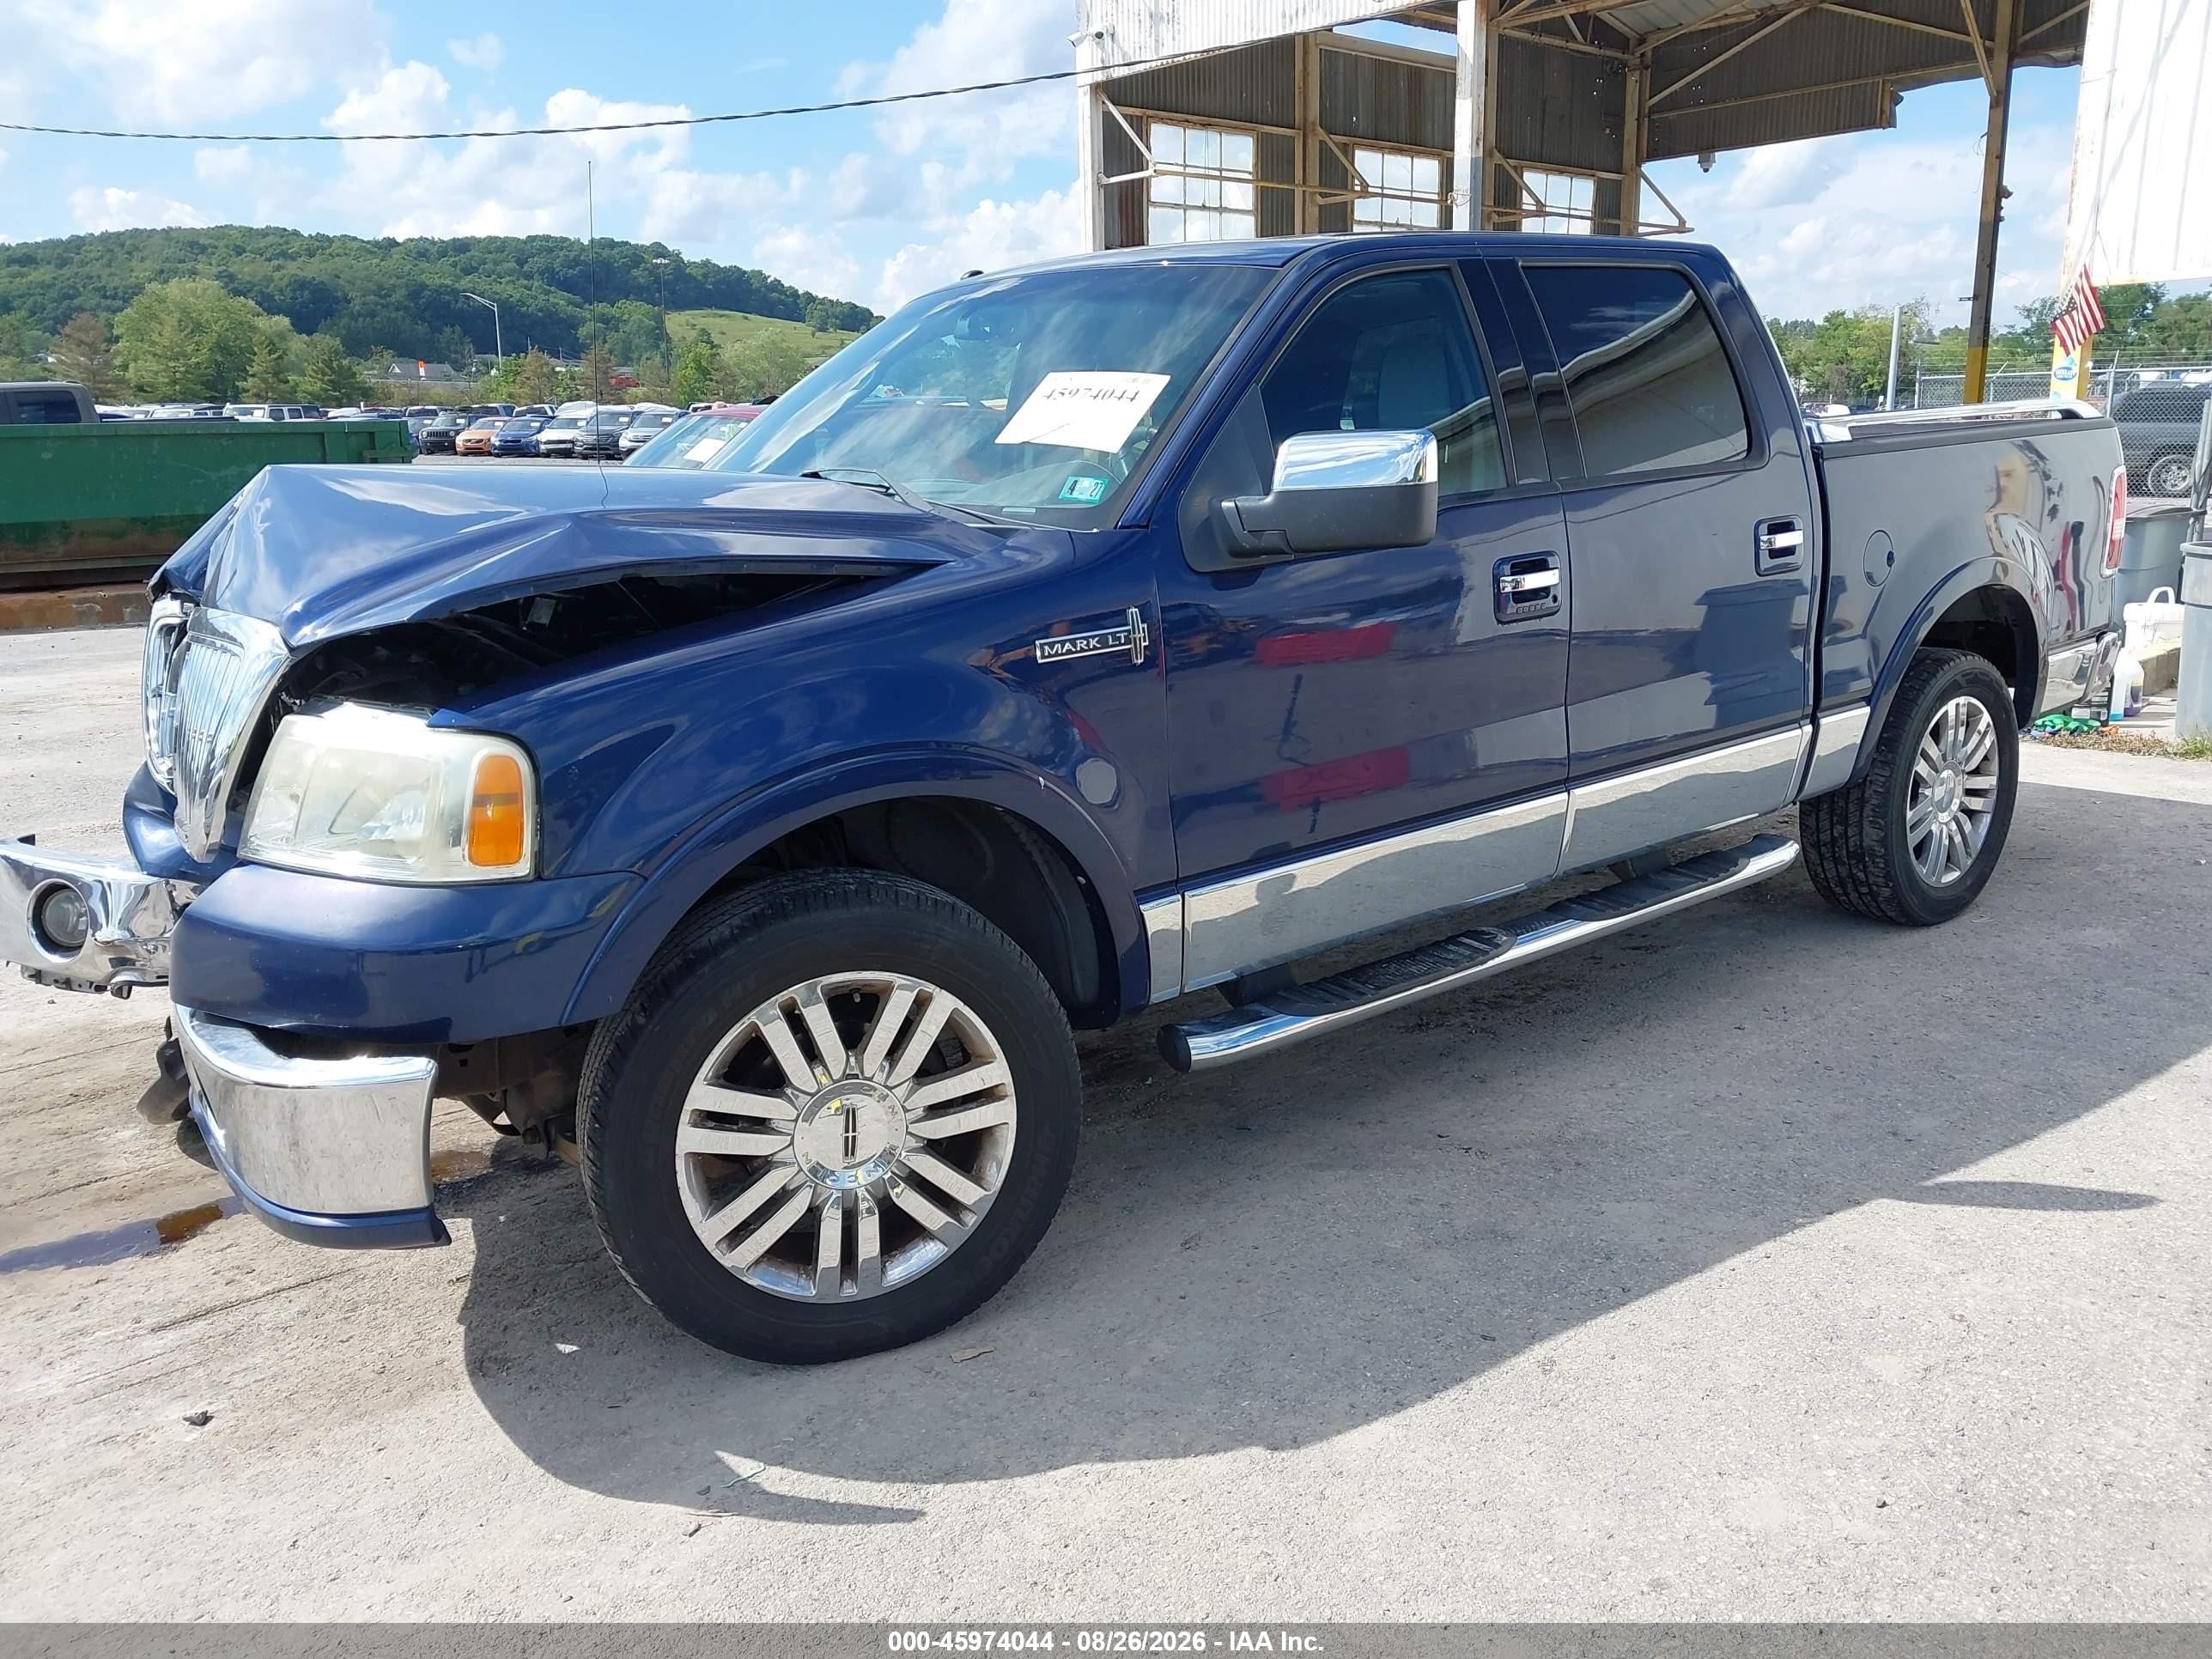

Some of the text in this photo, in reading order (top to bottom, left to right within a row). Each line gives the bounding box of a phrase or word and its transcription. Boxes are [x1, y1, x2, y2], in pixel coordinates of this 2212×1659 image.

[1090, 482, 1103, 498] 27
[1043, 632, 1127, 656] MARK LT
